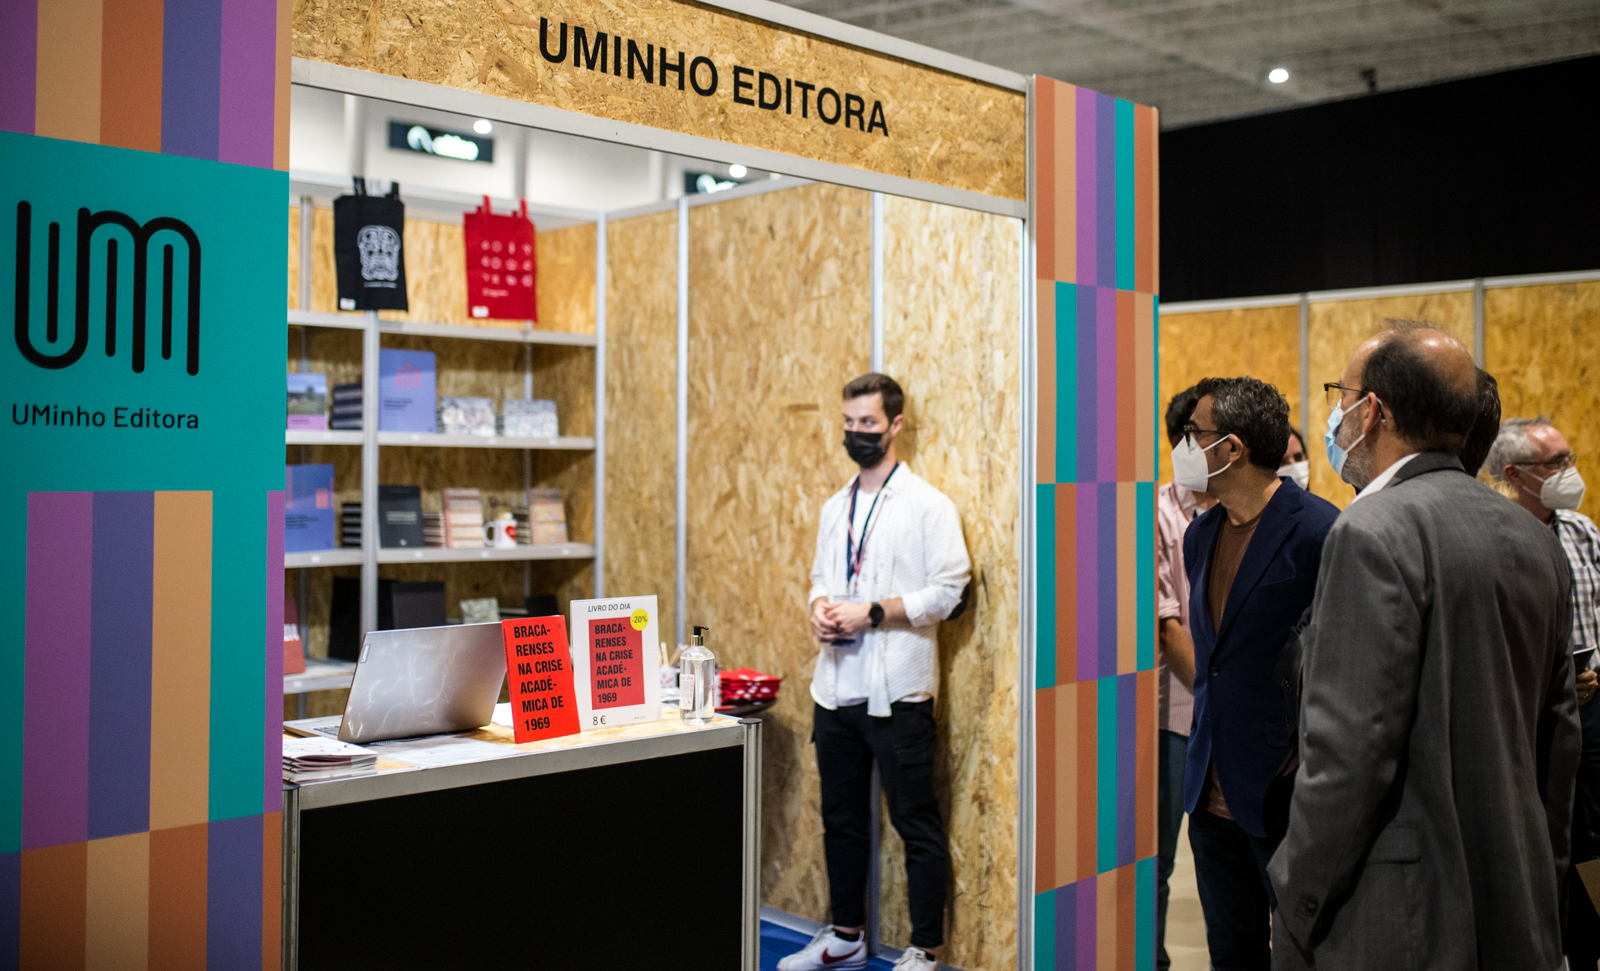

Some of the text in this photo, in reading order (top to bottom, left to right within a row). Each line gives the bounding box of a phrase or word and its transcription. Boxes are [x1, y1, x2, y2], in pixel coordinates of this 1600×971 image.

[539, 17, 889, 137] UMINHO EDITORA
[12, 404, 199, 429] UMinho Editora
[588, 604, 607, 612] LIVRO
[631, 616, 648, 624] -20%
[514, 624, 551, 639] BRACA-
[594, 623, 626, 635] BRACA-
[515, 641, 554, 657] RENSES
[595, 636, 627, 648] RENSES
[595, 649, 634, 662] NA CRISE
[518, 659, 563, 675] NA CRISE
[596, 662, 627, 676] ACADÉ-
[520, 675, 557, 694] ACADÉ-
[597, 676, 632, 690] MICA DE
[522, 695, 564, 713] MICA DE
[597, 692, 617, 704] 1969
[524, 716, 551, 732] 1969
[593, 715, 606, 726] 8 €
